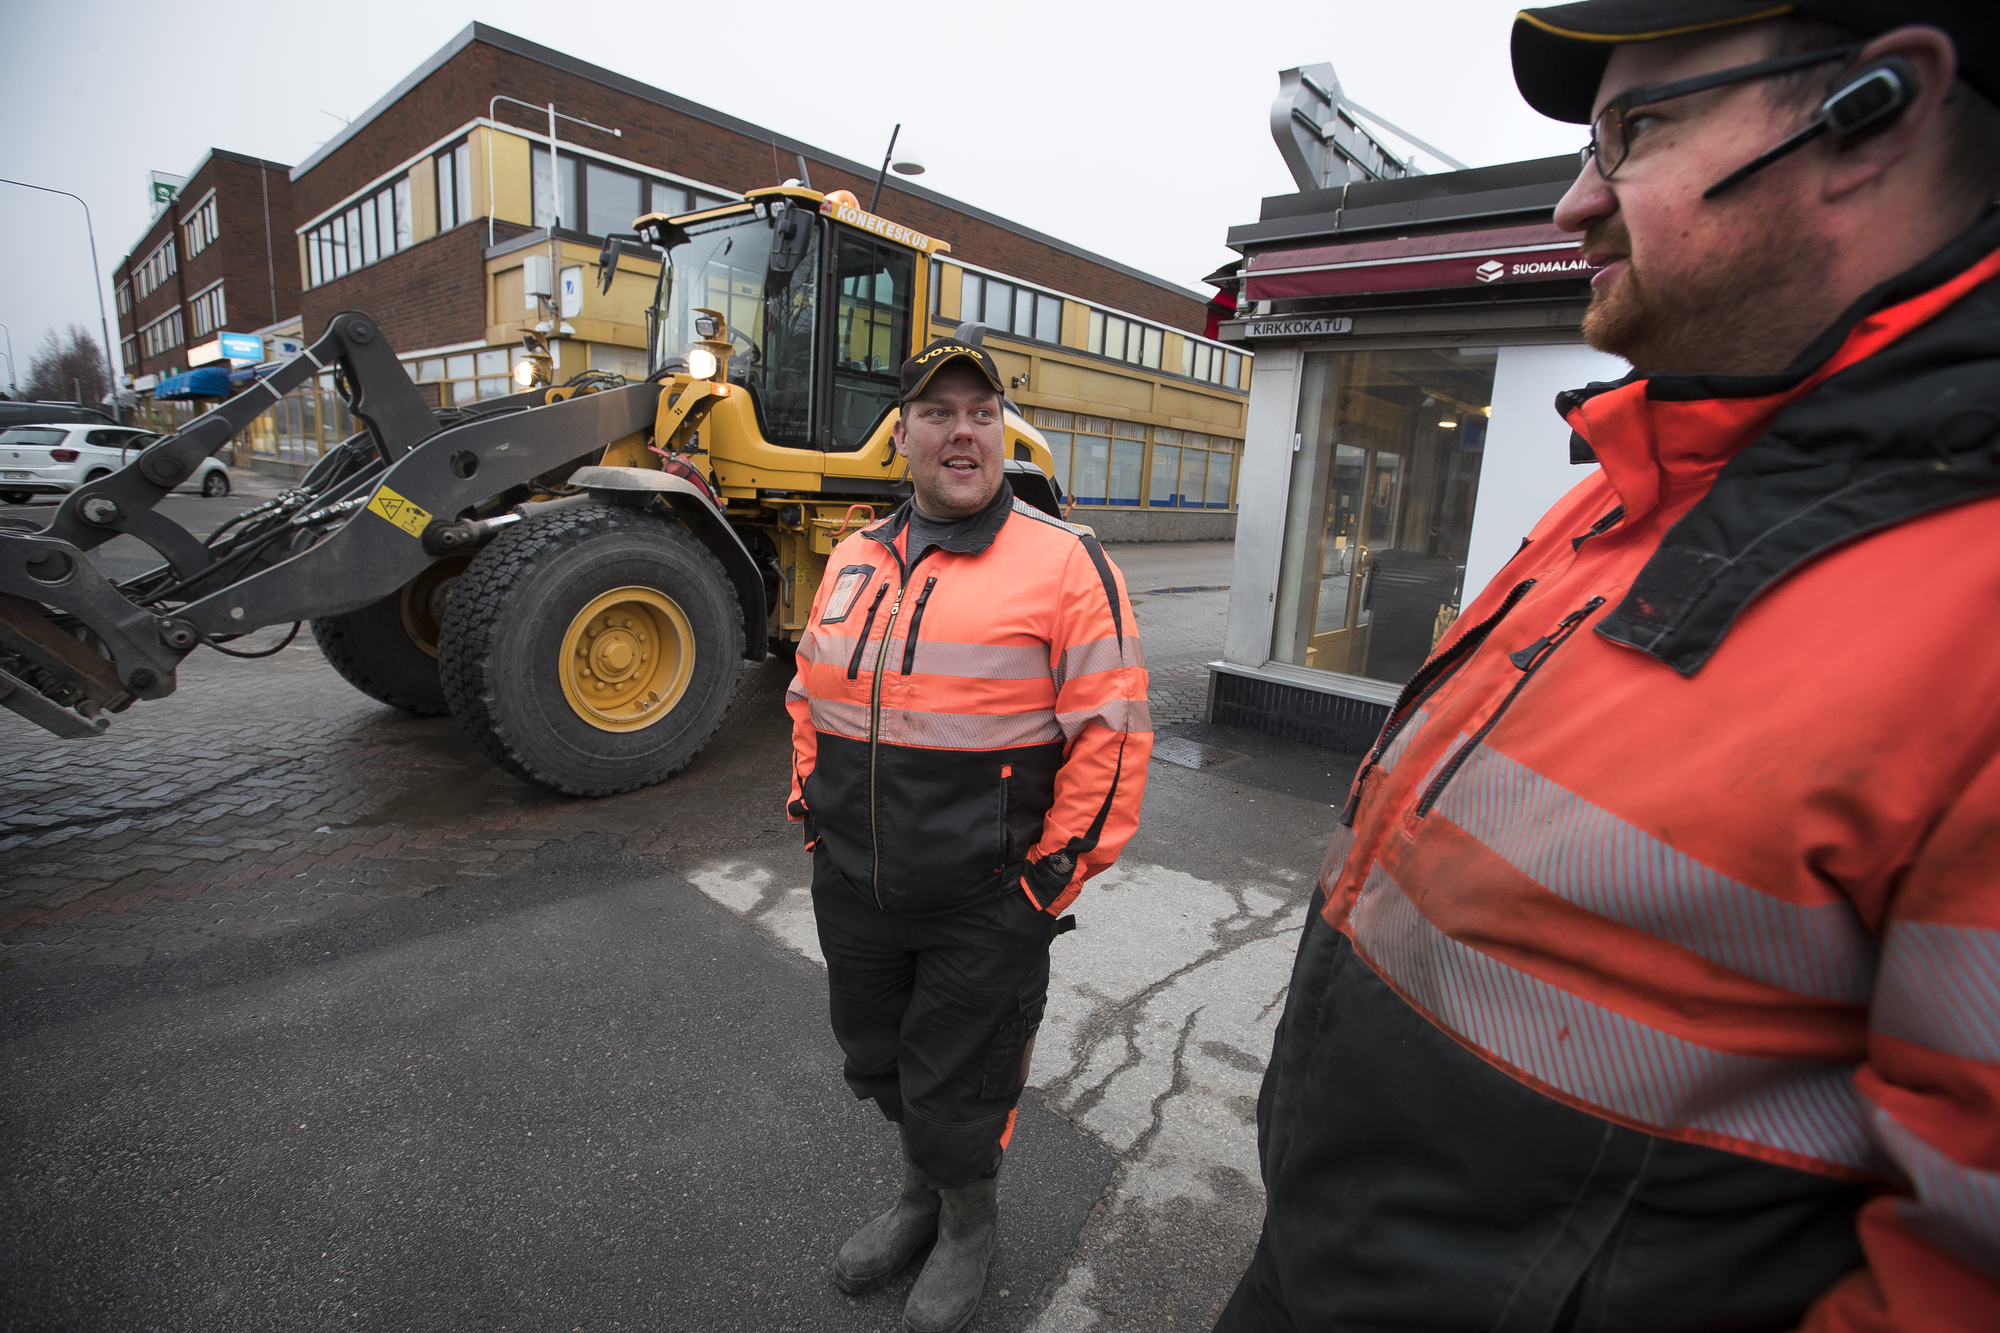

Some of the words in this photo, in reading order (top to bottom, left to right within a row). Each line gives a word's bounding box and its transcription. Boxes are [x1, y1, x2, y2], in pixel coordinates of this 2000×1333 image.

[836, 205, 929, 250] KONEKESKUS
[1512, 259, 1604, 275] SUOMALAIN
[1253, 320, 1343, 335] KIRKKOKATU
[915, 345, 984, 364] VOLVO
